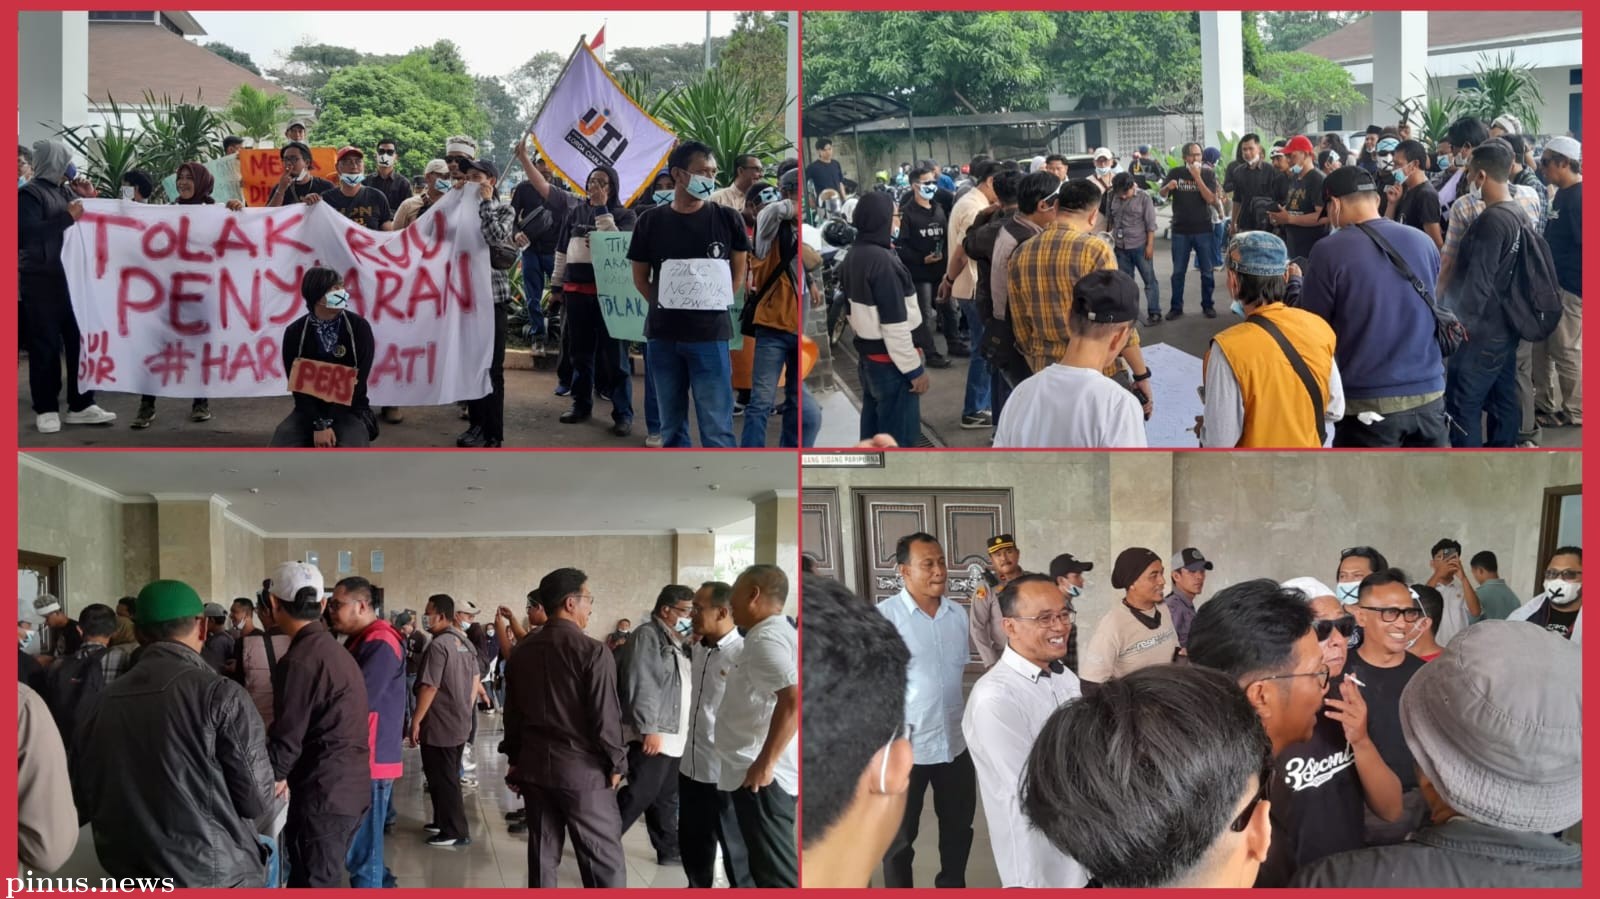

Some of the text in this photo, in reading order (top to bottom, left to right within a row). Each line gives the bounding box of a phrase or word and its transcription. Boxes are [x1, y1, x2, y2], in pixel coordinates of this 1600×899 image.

[77, 211, 315, 279] TOLAK
[117, 251, 476, 337] PENYARAN
[599, 294, 646, 317] TOLAK
[369, 341, 436, 387] ATI
[844, 455, 880, 464] PARIPURNA
